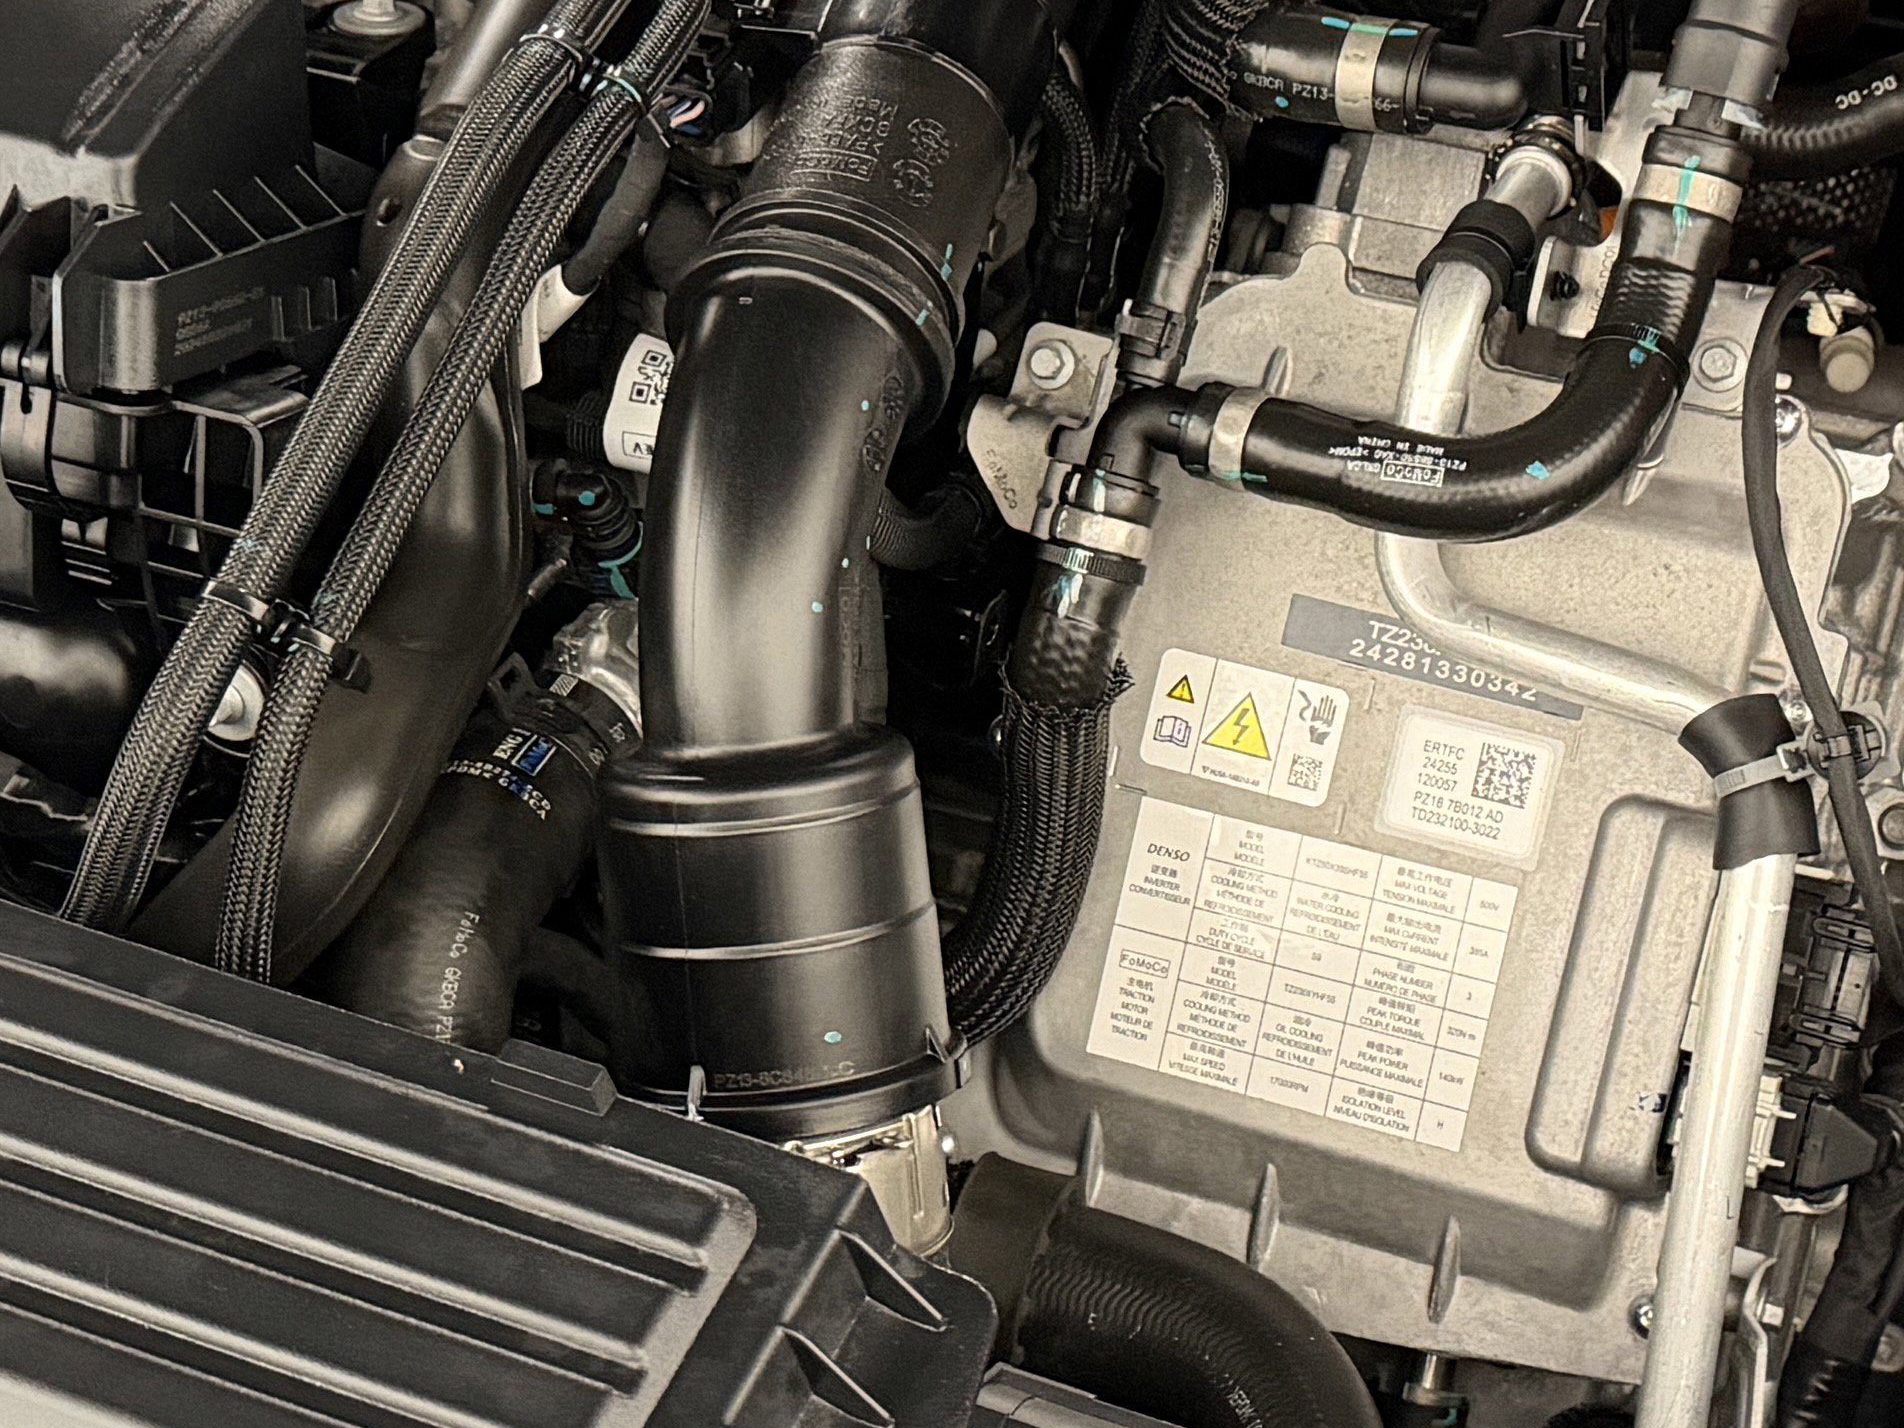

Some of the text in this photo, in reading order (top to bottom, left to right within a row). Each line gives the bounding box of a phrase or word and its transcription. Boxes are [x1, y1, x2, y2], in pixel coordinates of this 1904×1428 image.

[1422, 755, 1459, 775] 24255
[1416, 772, 1457, 792] 120057
[1409, 806, 1501, 840] TD232100-3022
[1484, 808, 1504, 824] AD
[1146, 842, 1190, 863] DENSO
[1120, 952, 1168, 974] FoMoCo
